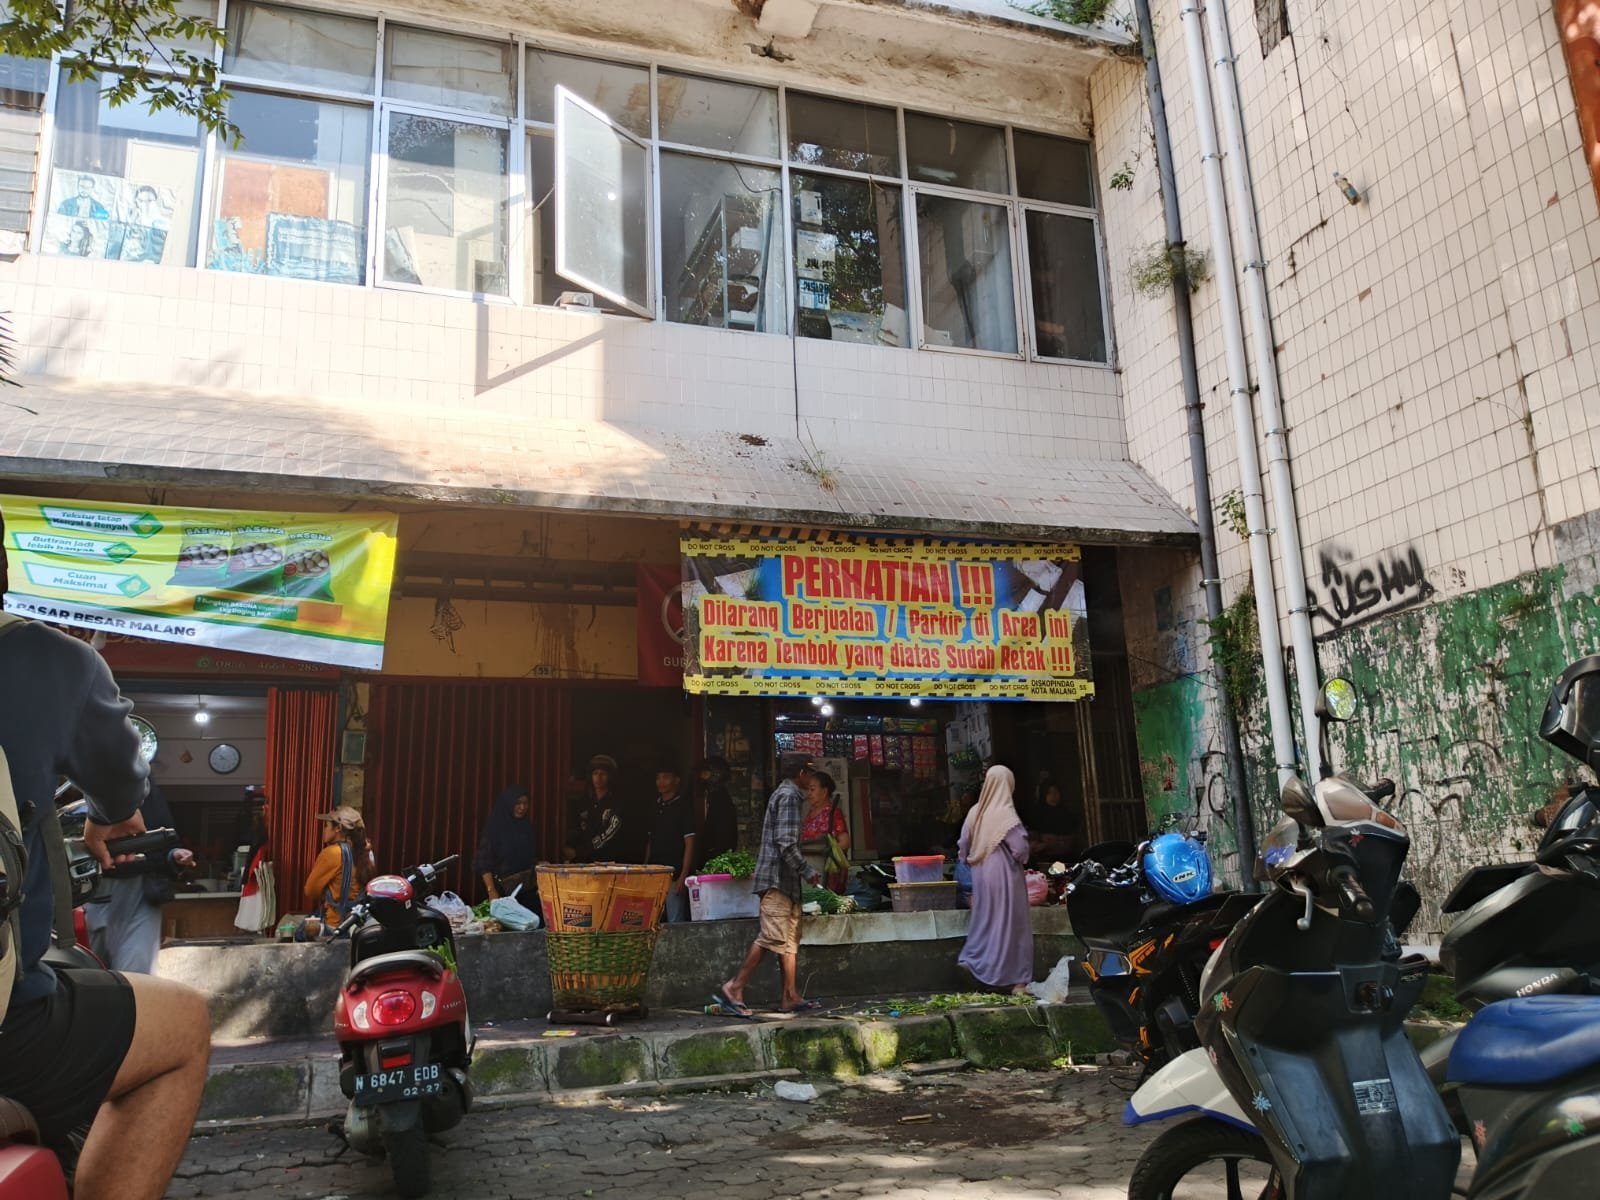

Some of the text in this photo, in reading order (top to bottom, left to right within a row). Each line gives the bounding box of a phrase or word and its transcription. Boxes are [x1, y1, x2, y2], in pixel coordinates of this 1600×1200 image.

[52, 576, 108, 590] Maksimal
[67, 571, 97, 581] Cuan
[784, 554, 993, 605] PERHATIAN !!!
[16, 603, 70, 619] PASAR
[74, 612, 126, 628] BESAR
[130, 622, 197, 637] MALANG
[704, 600, 1069, 638] Dilarang Berjualan / Parkir di Area ini
[704, 635, 1071, 672] Karena Tembok yang diatas Sudah Retak !!!
[1031, 680, 1075, 688] DISKOPINDAG
[1516, 972, 1559, 998] HONDA
[356, 1065, 439, 1091] N 6847 EDB
